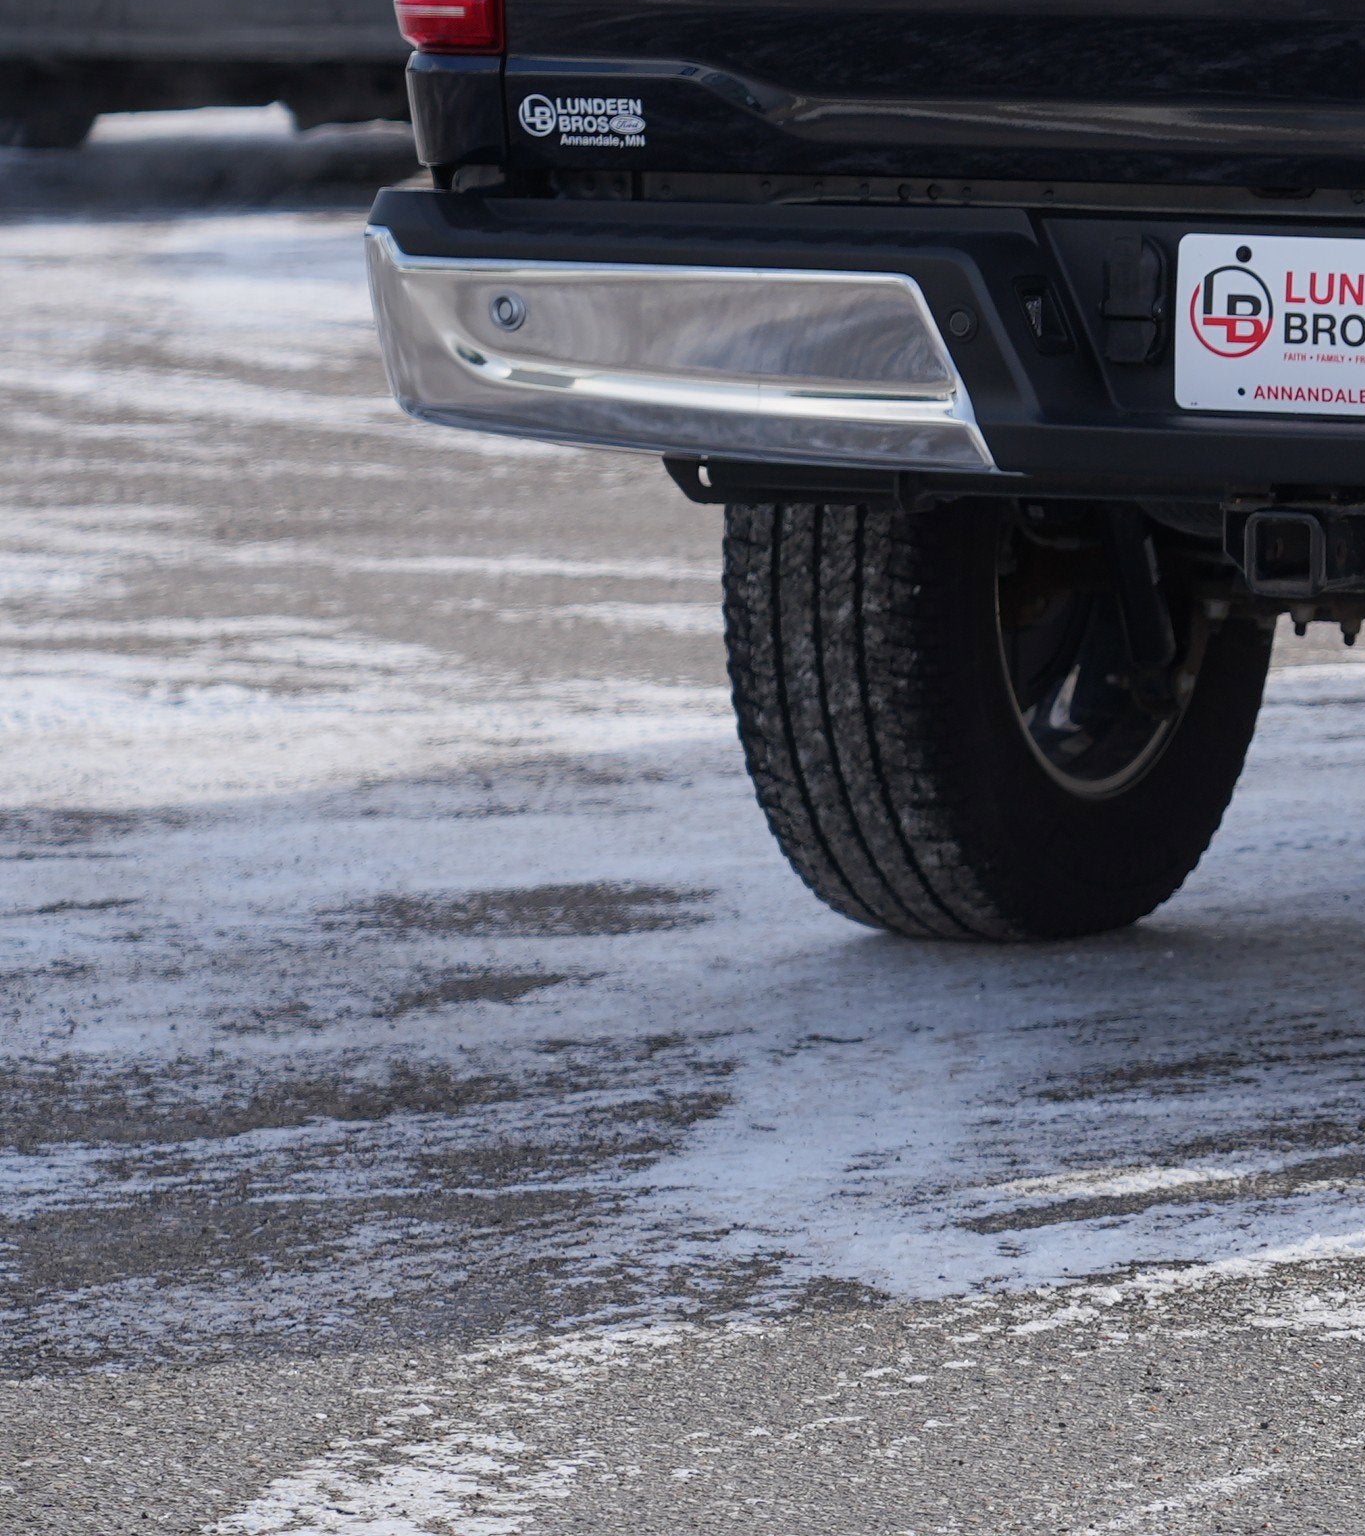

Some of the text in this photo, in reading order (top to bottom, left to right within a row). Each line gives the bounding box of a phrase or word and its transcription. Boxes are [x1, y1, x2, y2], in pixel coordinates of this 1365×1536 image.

[556, 97, 642, 115] LUNDEEN
[559, 115, 610, 133] BROS
[560, 133, 645, 148] Annandale, MN
[1283, 352, 1307, 362] FAITH
[1316, 354, 1345, 363] FAMILY
